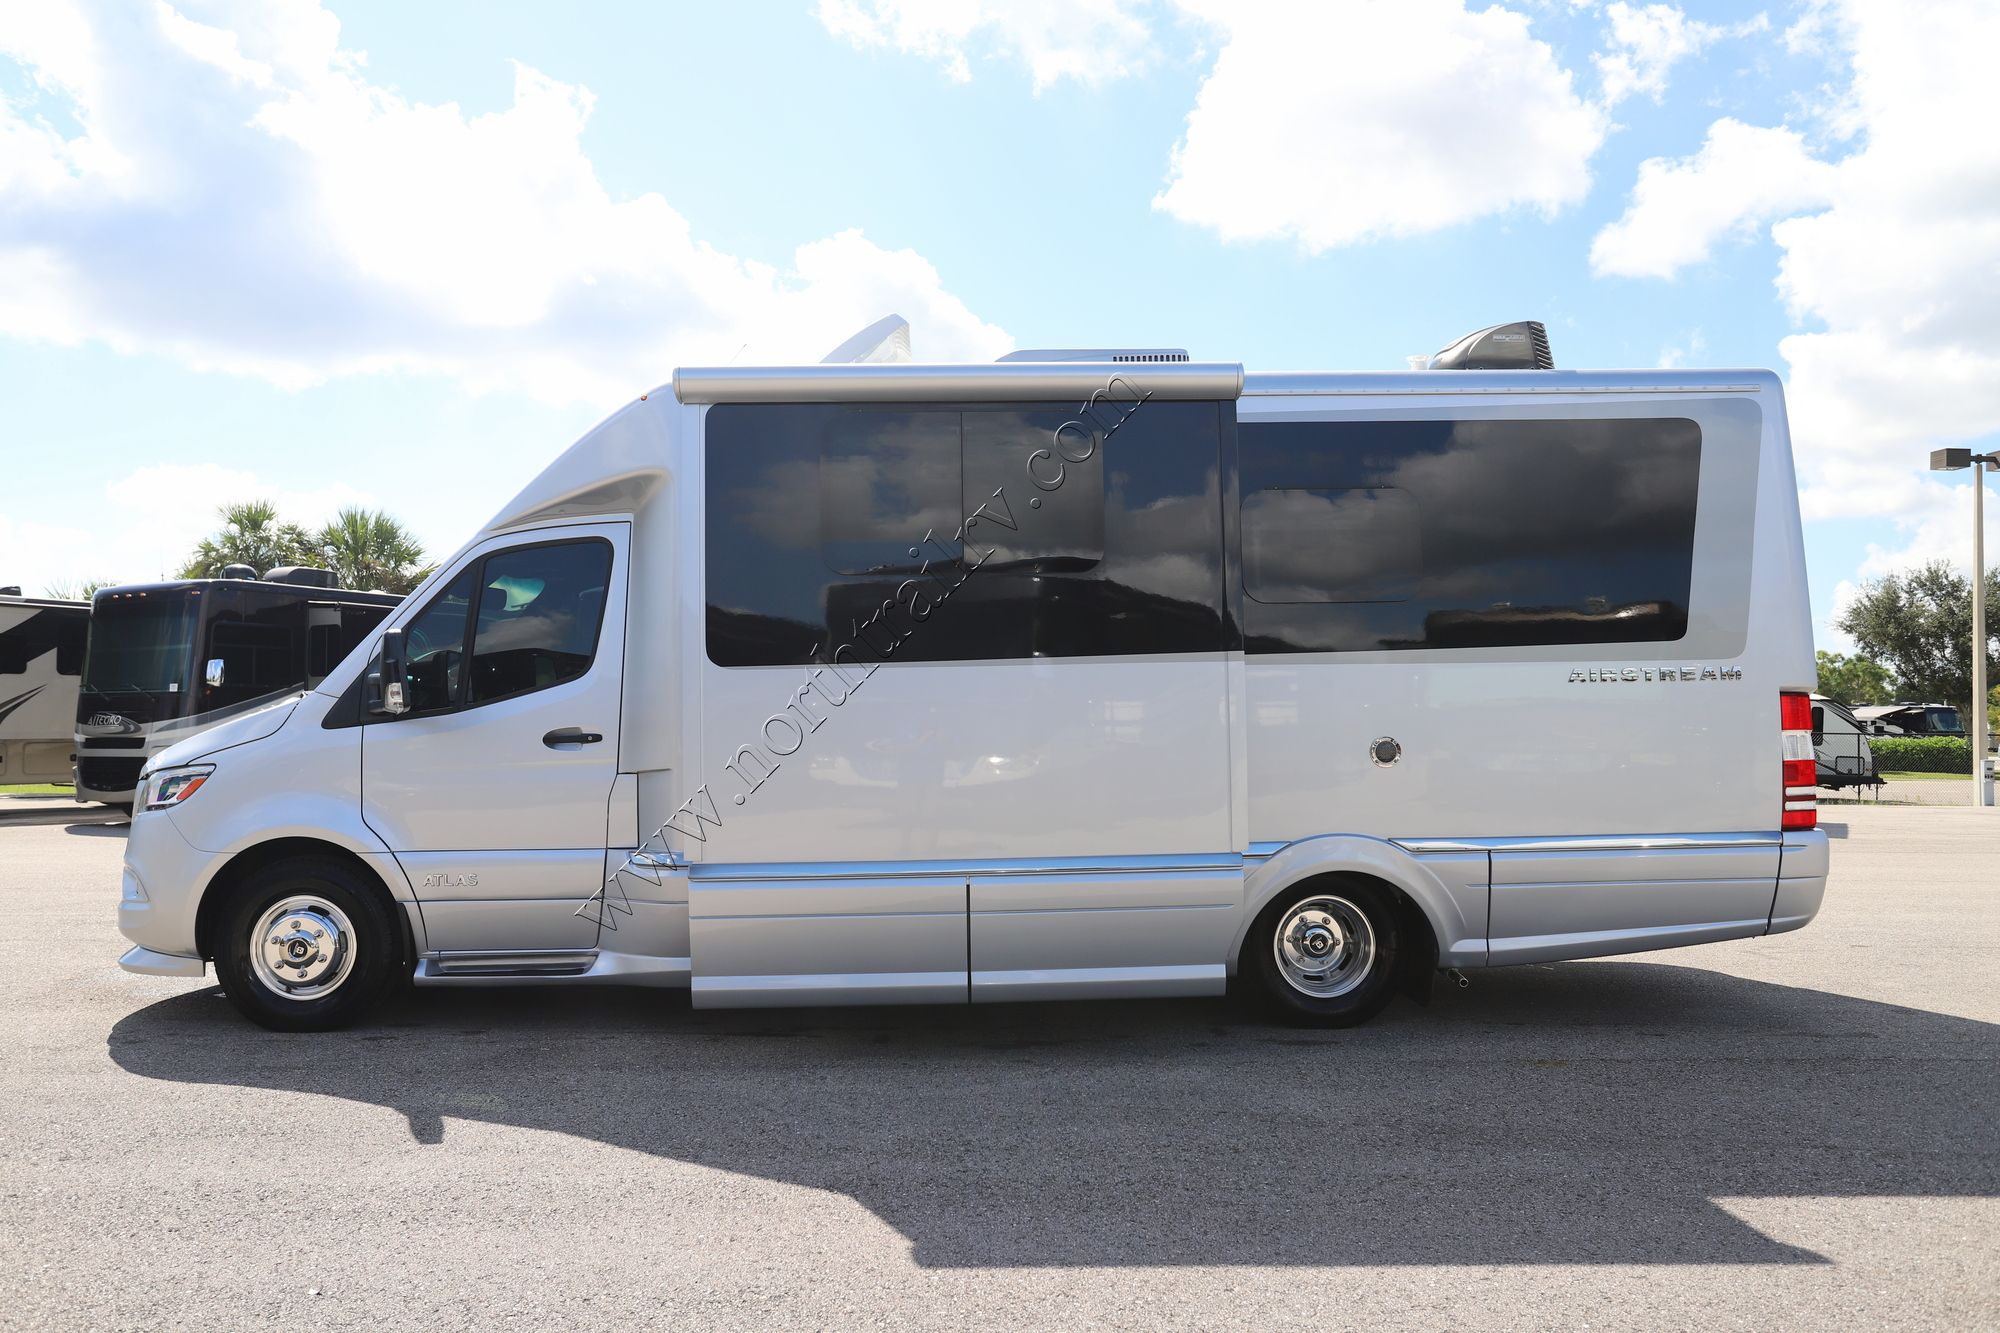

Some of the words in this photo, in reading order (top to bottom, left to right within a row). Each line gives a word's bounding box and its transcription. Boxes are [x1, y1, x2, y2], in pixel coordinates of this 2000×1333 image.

[1568, 664, 1743, 683] AIRSTREAM
[87, 715, 122, 727] ALLEGRO
[423, 873, 479, 887] ATLAS
